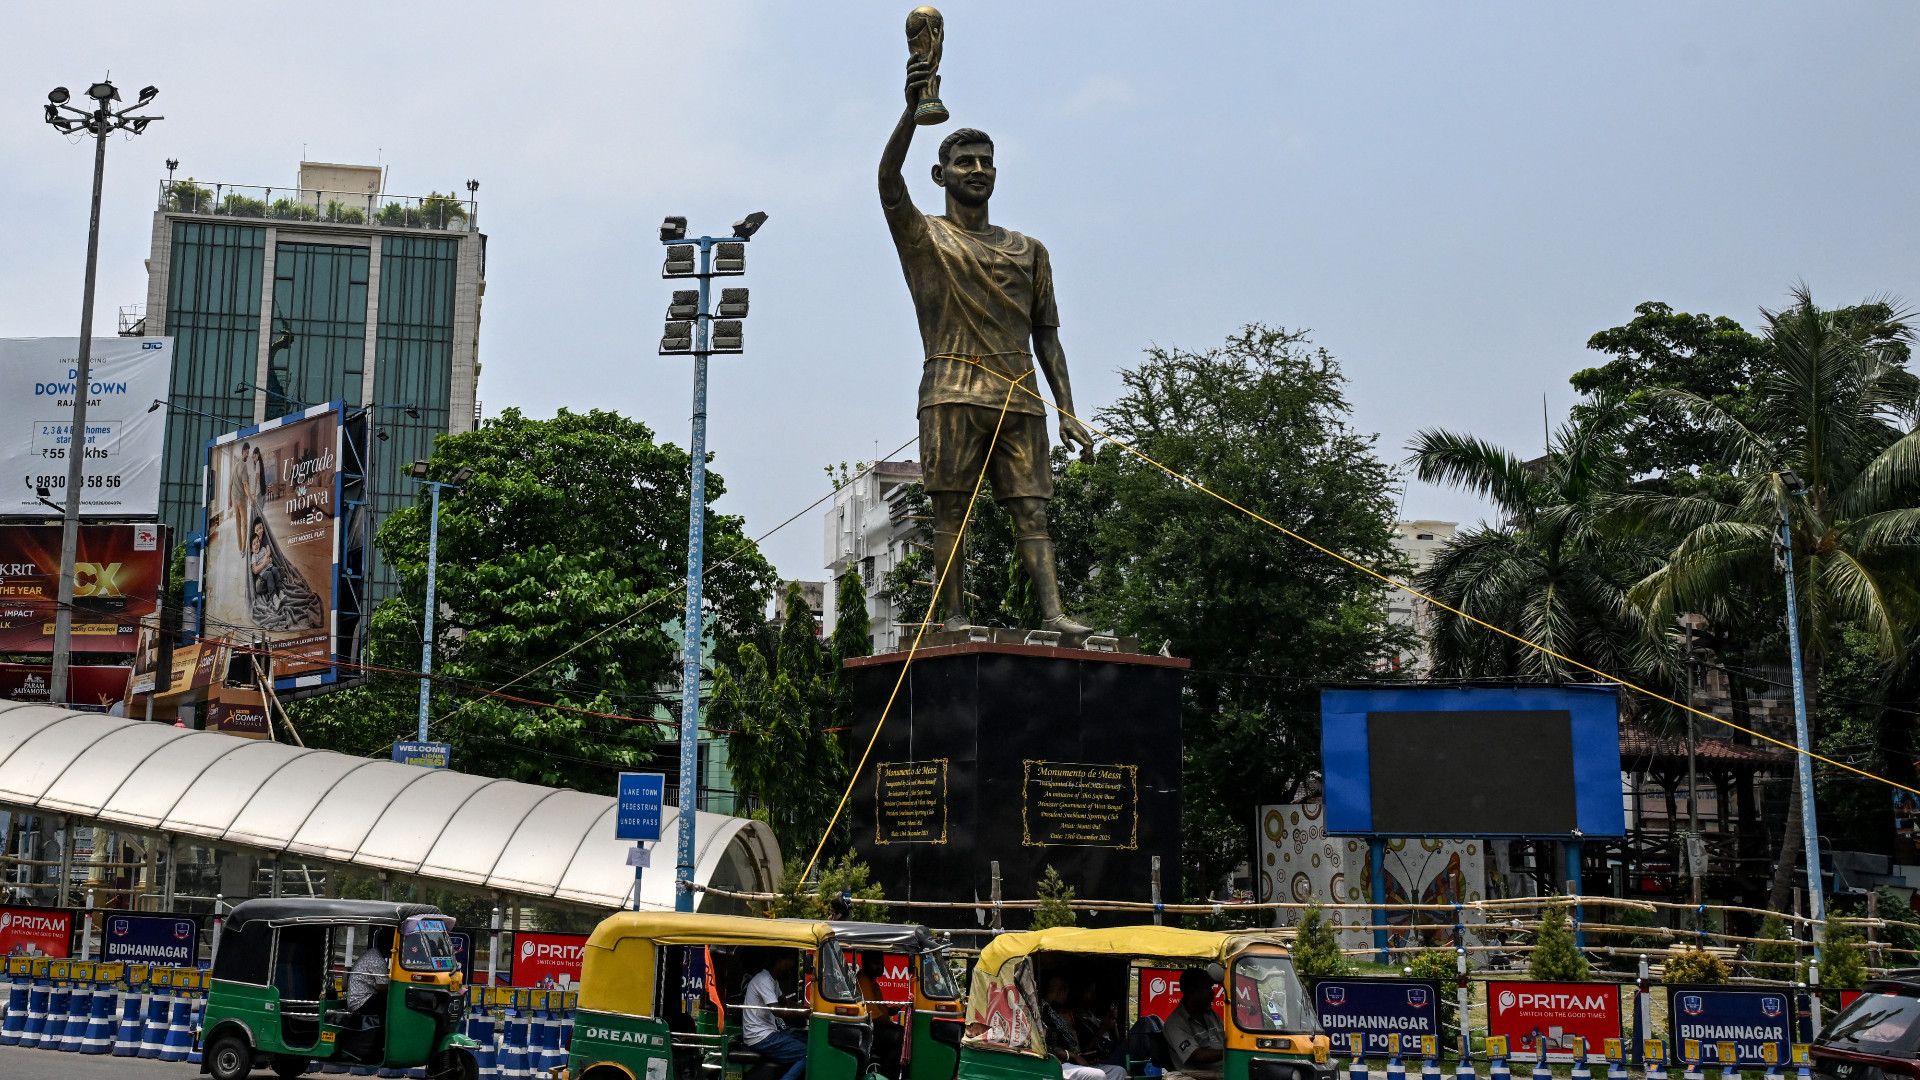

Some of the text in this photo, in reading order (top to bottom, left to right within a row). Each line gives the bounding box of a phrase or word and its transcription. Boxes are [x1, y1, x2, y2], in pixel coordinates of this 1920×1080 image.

[35, 383, 126, 395] DOWNOWN
[283, 447, 333, 486] Upgrade
[36, 476, 65, 488] 9830
[88, 476, 102, 488] 58
[106, 476, 120, 488] 56
[286, 490, 328, 514] morva
[18, 586, 42, 595] YEAR
[235, 714, 263, 722] COMFY
[399, 745, 446, 753] WELCOME
[1037, 767, 1121, 779] Monumento de Messi
[12, 916, 65, 931] PRITAM
[109, 943, 188, 958] BIDHANNAGAR
[1519, 994, 1605, 1010] PRITAM
[1323, 1014, 1429, 1030] BIDHANNAGAR
[586, 1028, 647, 1044] DREAM
[1681, 1025, 1783, 1040] BIDHANNAGAR
